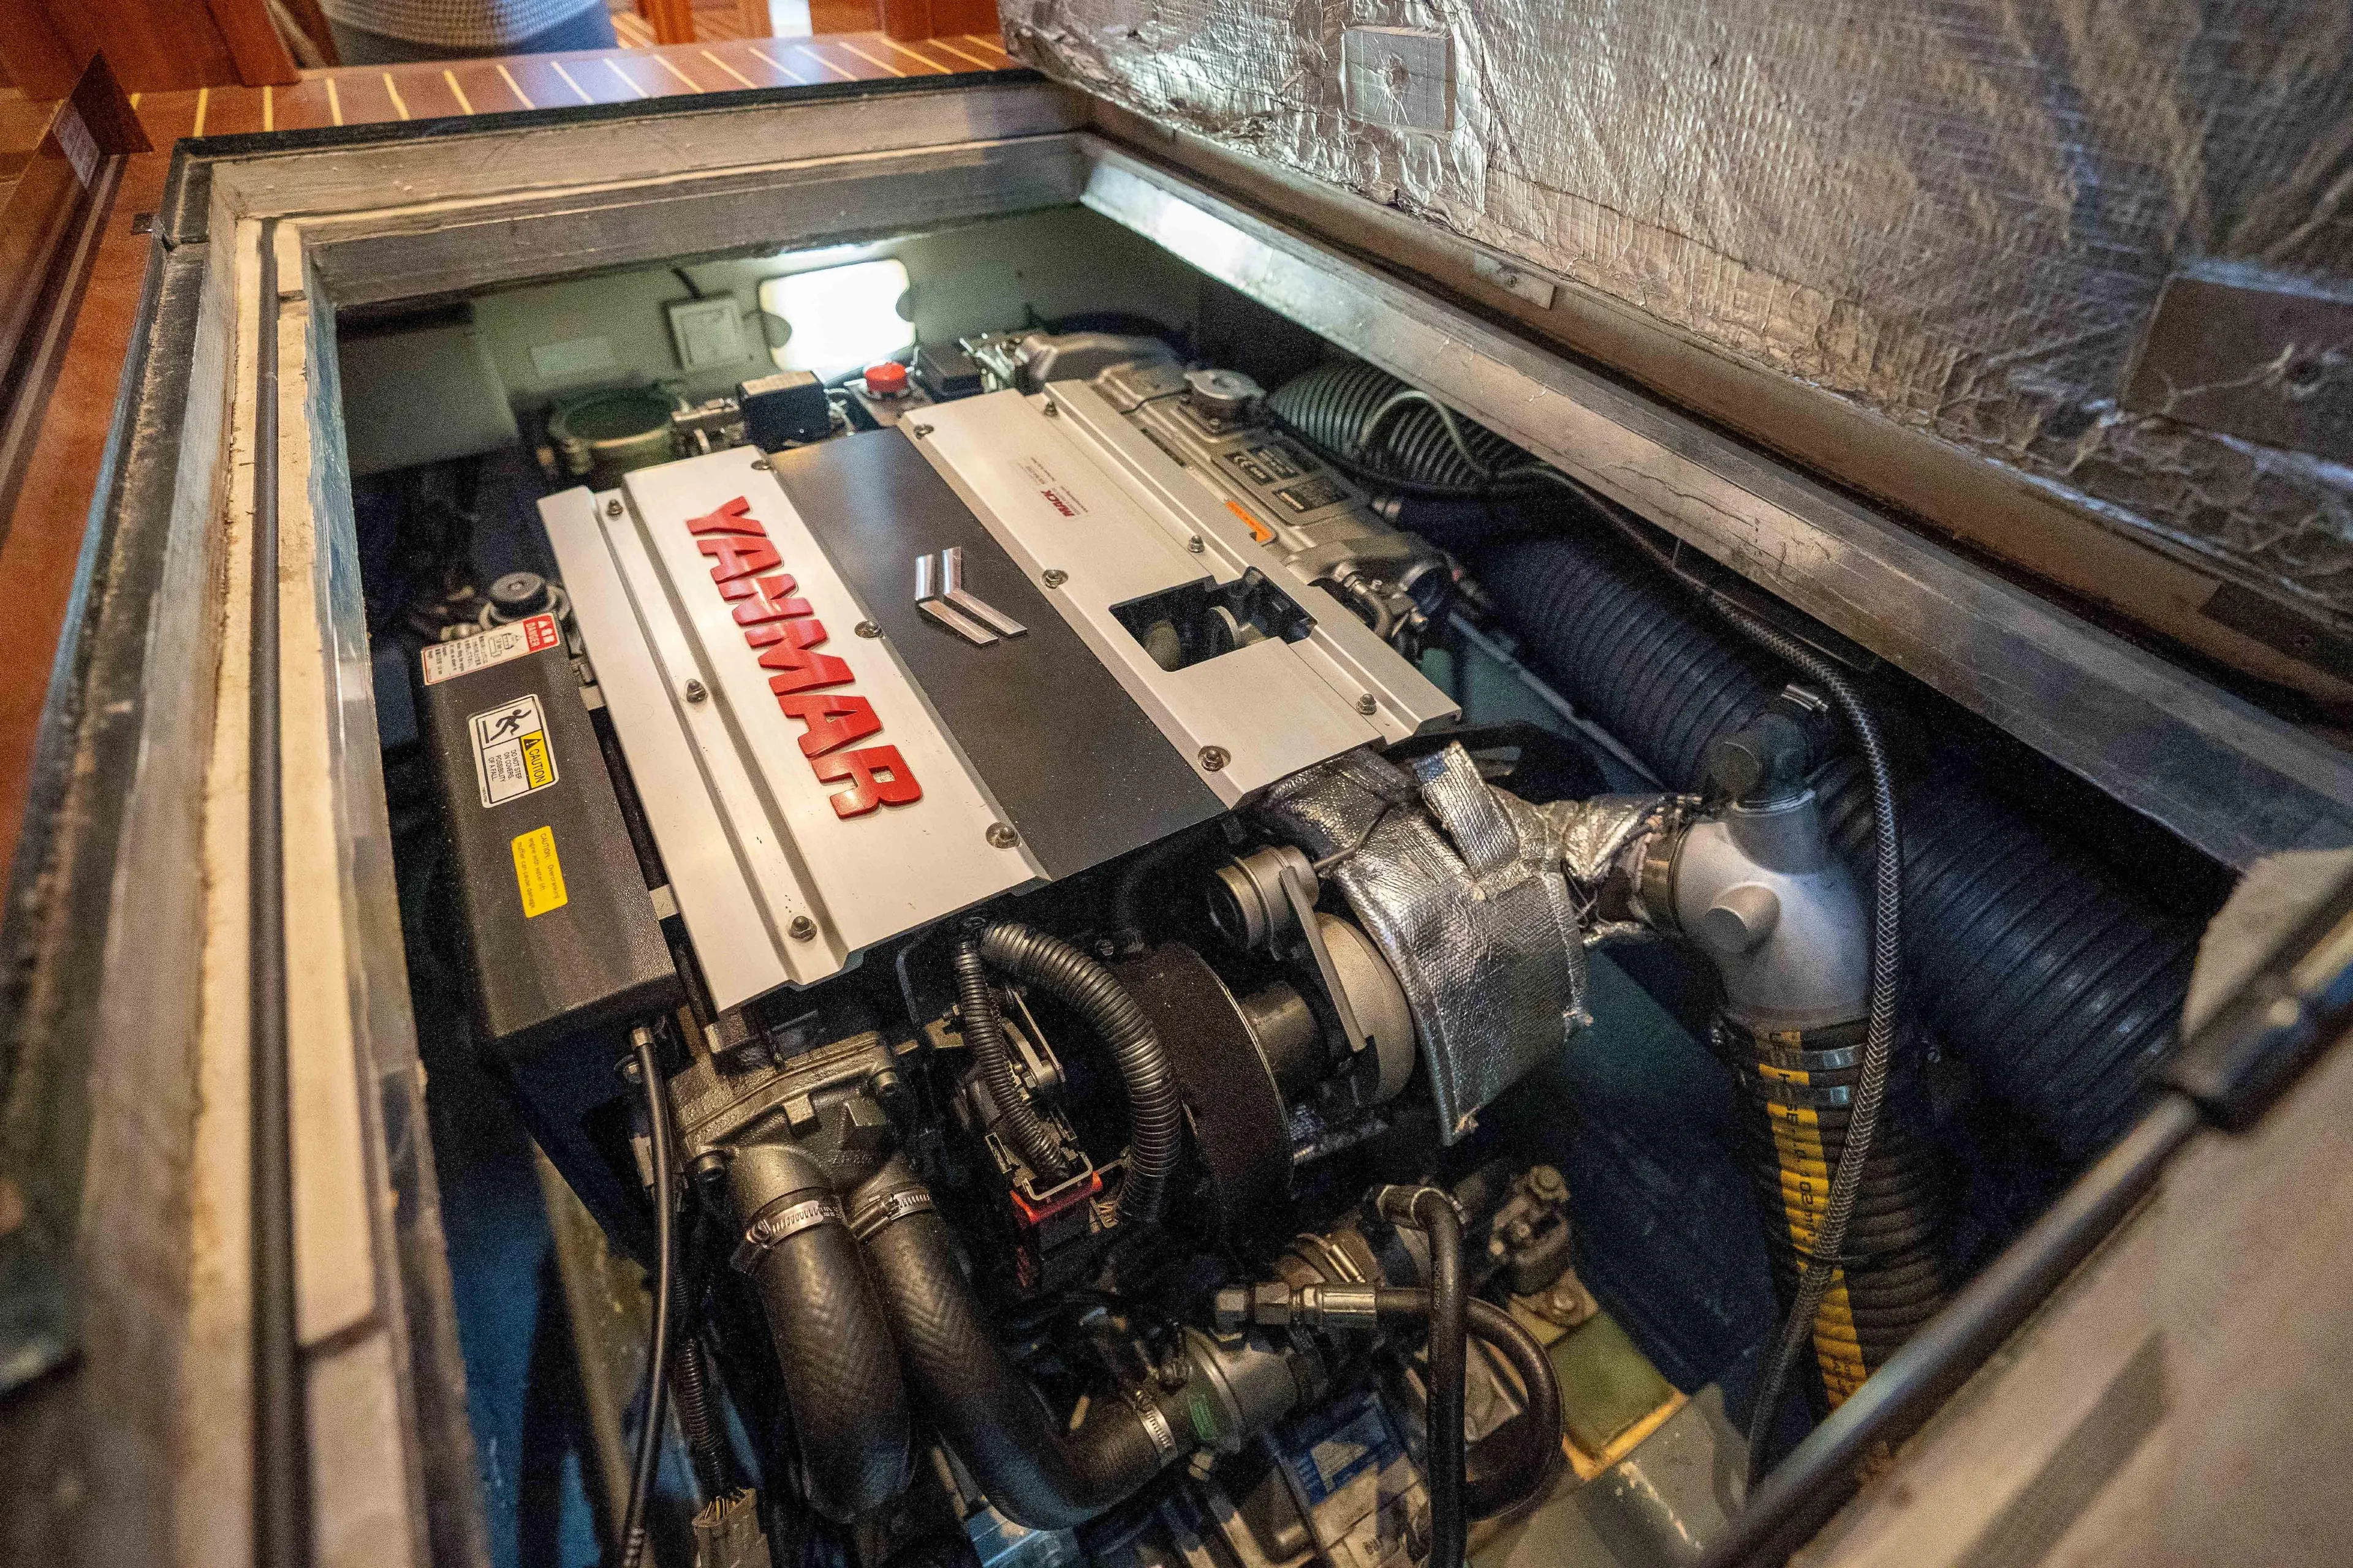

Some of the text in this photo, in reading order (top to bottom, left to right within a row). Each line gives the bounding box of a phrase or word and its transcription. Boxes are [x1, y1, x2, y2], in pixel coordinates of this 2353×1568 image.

[1040, 490, 1074, 517] MACK
[525, 621, 540, 647] DANGER
[686, 495, 923, 820] YANMAR
[496, 755, 506, 782] POSSIBILITY
[506, 760, 514, 780] COVERS.
[529, 749, 546, 783] CAUTION
